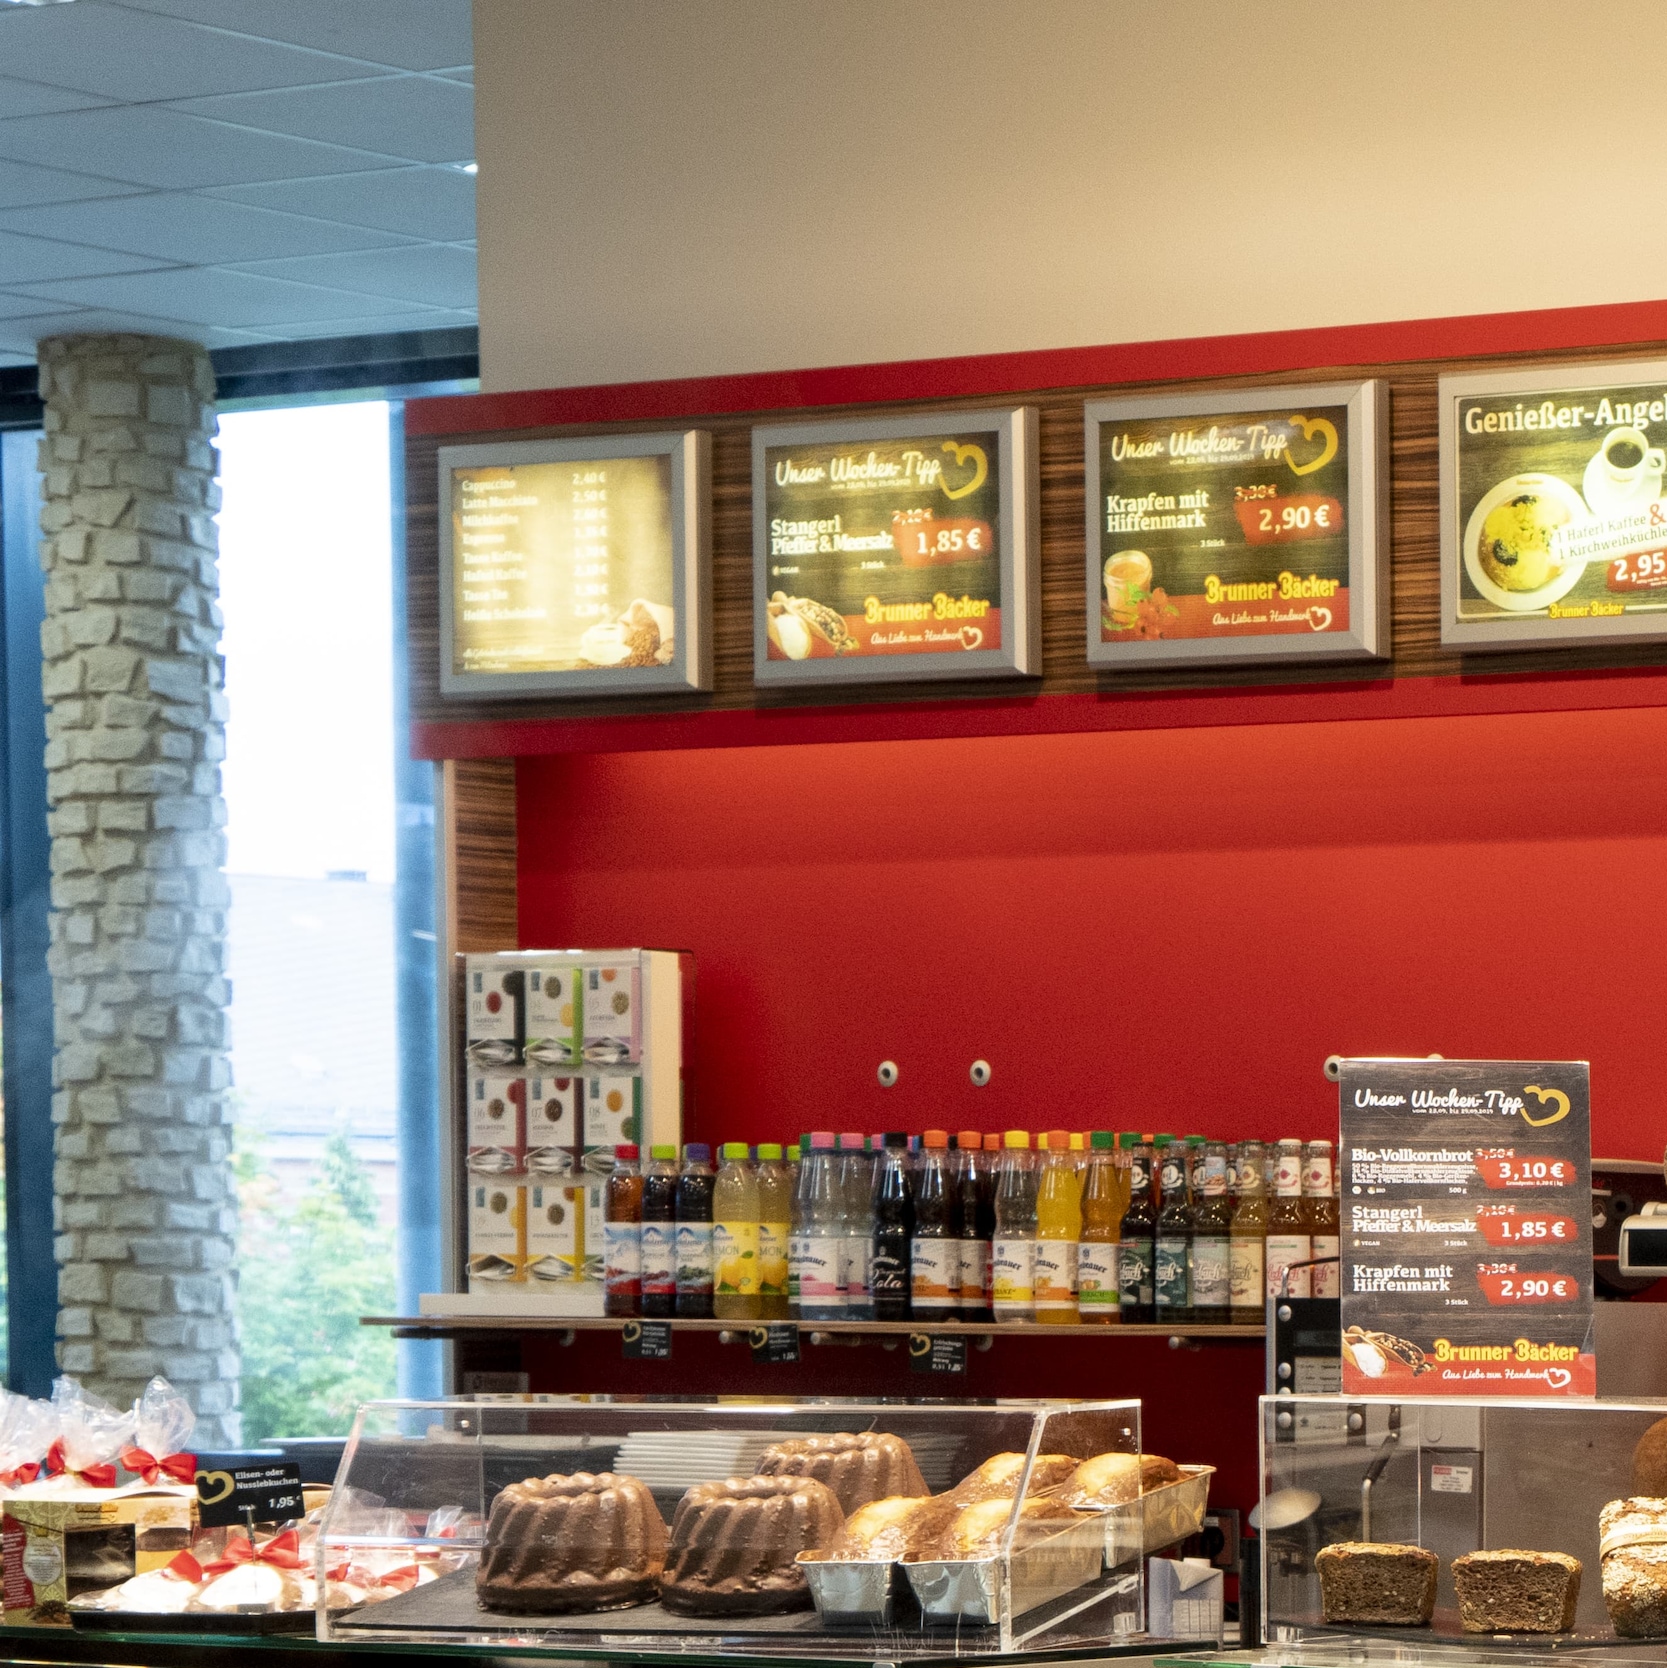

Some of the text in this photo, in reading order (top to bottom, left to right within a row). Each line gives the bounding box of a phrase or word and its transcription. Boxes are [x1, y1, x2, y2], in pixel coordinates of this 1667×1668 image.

[1112, 434, 1164, 461] Unser
[1170, 425, 1287, 459] Wochen-Tipp
[775, 451, 941, 486] Unser Wochen-Tipp
[1107, 490, 1209, 518] Krapfen mit
[771, 515, 840, 537] Stangerl
[1107, 511, 1206, 532] Hiffenmark
[1259, 506, 1310, 534] 2,90
[1608, 504, 1667, 532] Kaffee &
[772, 531, 894, 555] Pfeffer & Meersalz
[917, 529, 963, 556] 1,85
[1569, 525, 1667, 558] Kirchweihküchle
[1614, 552, 1665, 582] 2,95
[1205, 571, 1338, 603] Brunner Bäcker
[864, 592, 989, 624] Brunner Bäcker
[1550, 603, 1590, 619] Brunner
[1355, 1089, 1524, 1115] Unser Wochen-Tipp
[1352, 1148, 1473, 1163] Bio-Vollkornbrot
[1499, 1163, 1546, 1179] 3,10
[1352, 1206, 1423, 1220] Stangerl
[1353, 1219, 1477, 1233] Pfeffer & Meersalz
[1502, 1222, 1547, 1240] 1,85
[1354, 1265, 1453, 1282] Krapfen mit
[1354, 1279, 1450, 1292] Hiffenmark
[1501, 1281, 1548, 1299] 2,90
[1434, 1338, 1578, 1362] Brunner Bäcker
[237, 1478, 298, 1489] Nusslebkuchen
[269, 1496, 294, 1508] 1,95
